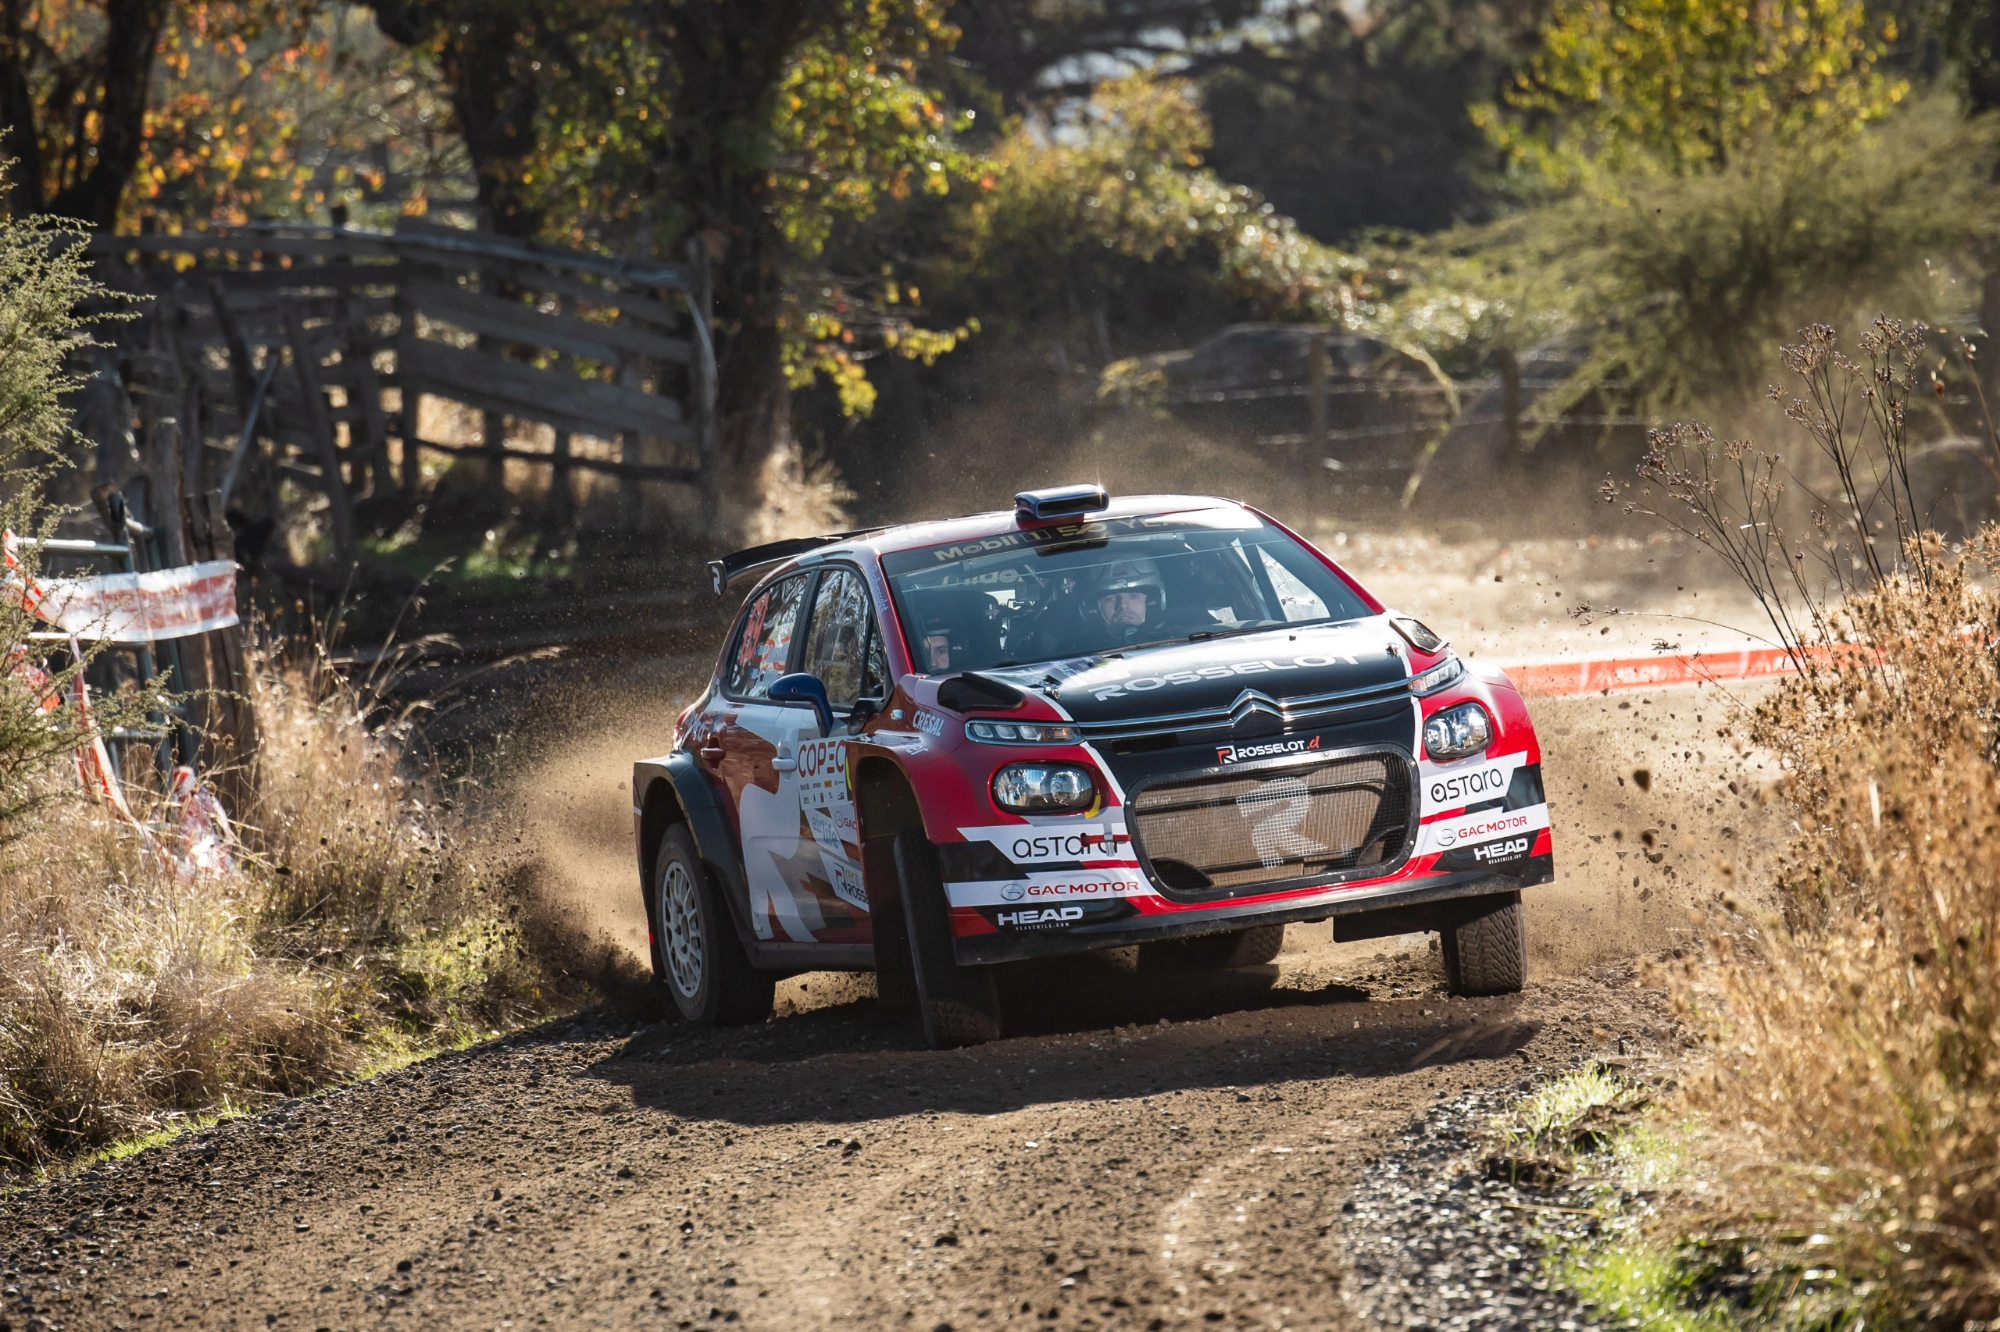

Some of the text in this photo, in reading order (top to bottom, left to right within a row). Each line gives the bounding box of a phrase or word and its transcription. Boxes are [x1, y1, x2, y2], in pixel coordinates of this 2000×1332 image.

[933, 534, 1019, 561] Mobil
[1088, 654, 1361, 702] ROSSELOT
[913, 709, 945, 737] CRESAL
[798, 739, 847, 778] COPEC
[1431, 768, 1504, 803] astara
[1458, 816, 1528, 839] GAC MOTOR
[1473, 838, 1528, 861] HEAD
[1027, 881, 1139, 896] GAC MOTOR
[997, 906, 1084, 926] HEAD
